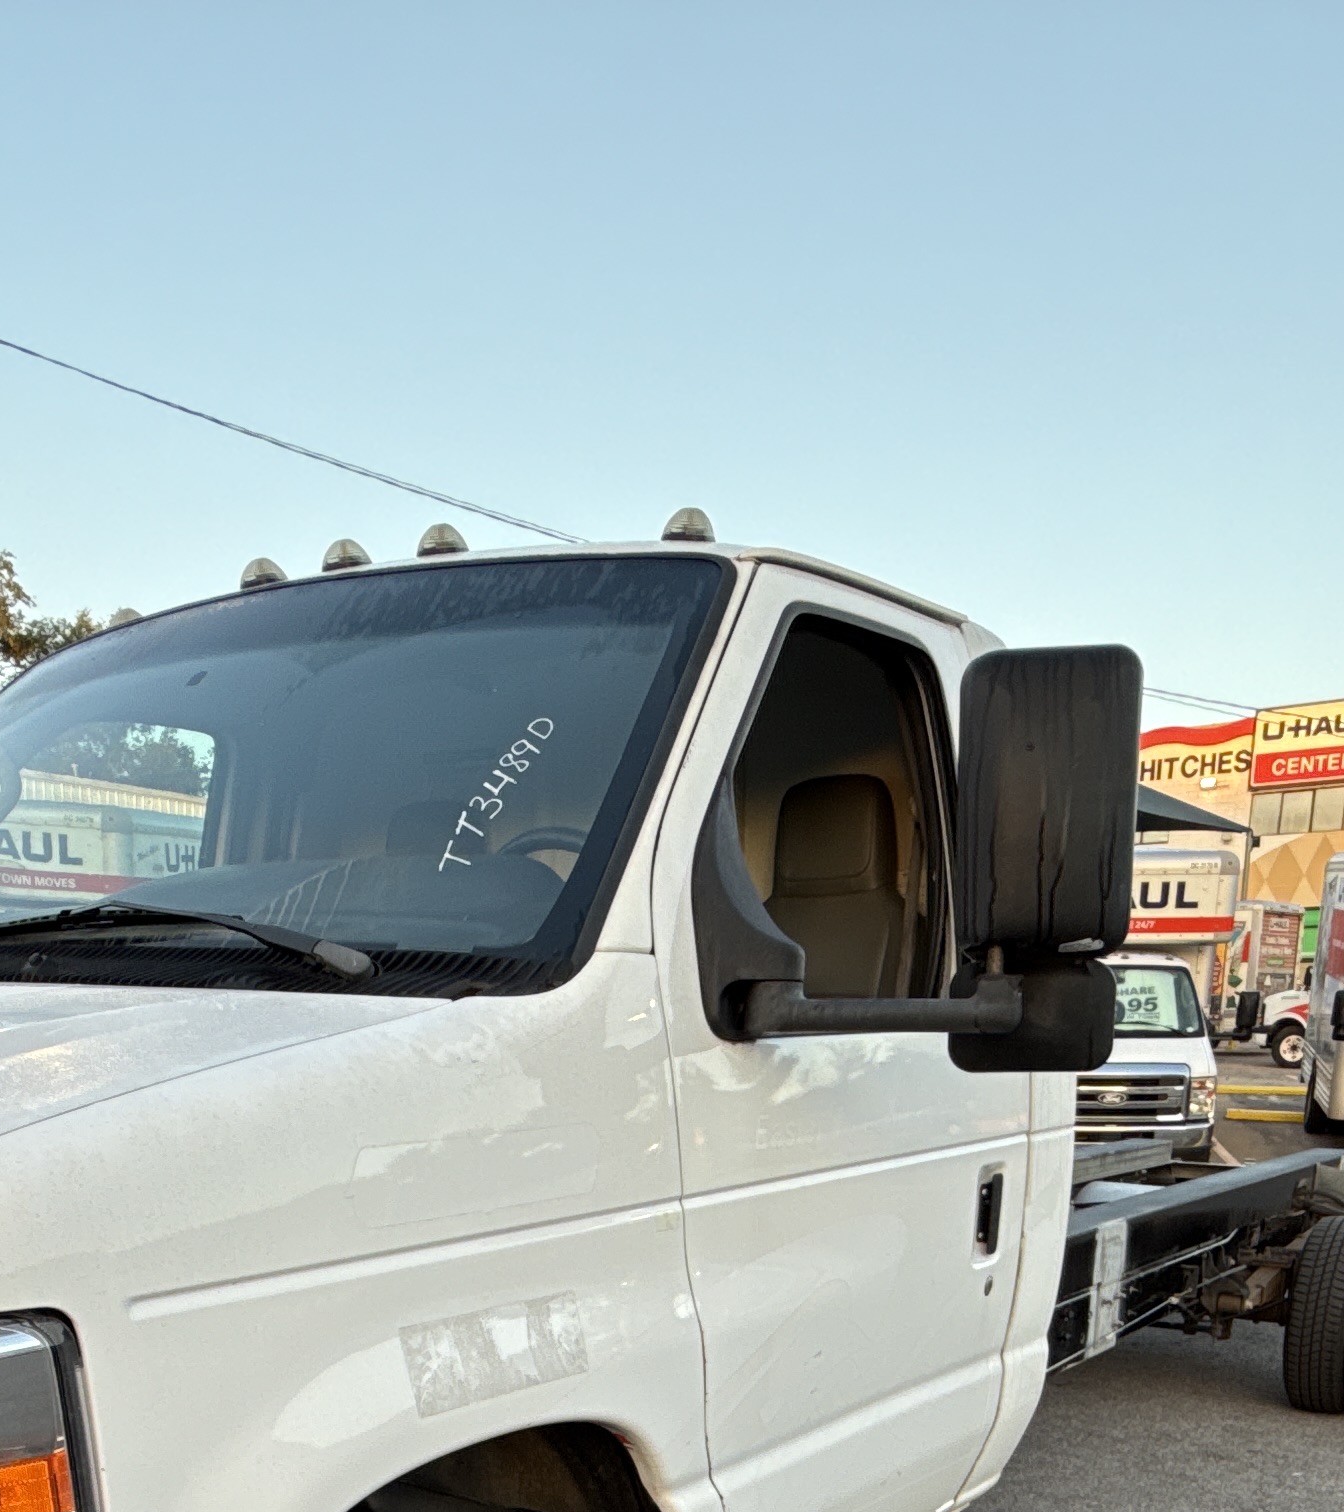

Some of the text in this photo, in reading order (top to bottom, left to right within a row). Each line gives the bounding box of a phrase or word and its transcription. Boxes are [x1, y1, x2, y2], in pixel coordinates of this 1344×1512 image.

[1140, 750, 1252, 782] HITCHES
[438, 717, 555, 872] TT3489D
[34, 876, 77, 889] MOVES
[1134, 920, 1156, 929] 24/7
[1116, 986, 1156, 996] HARE
